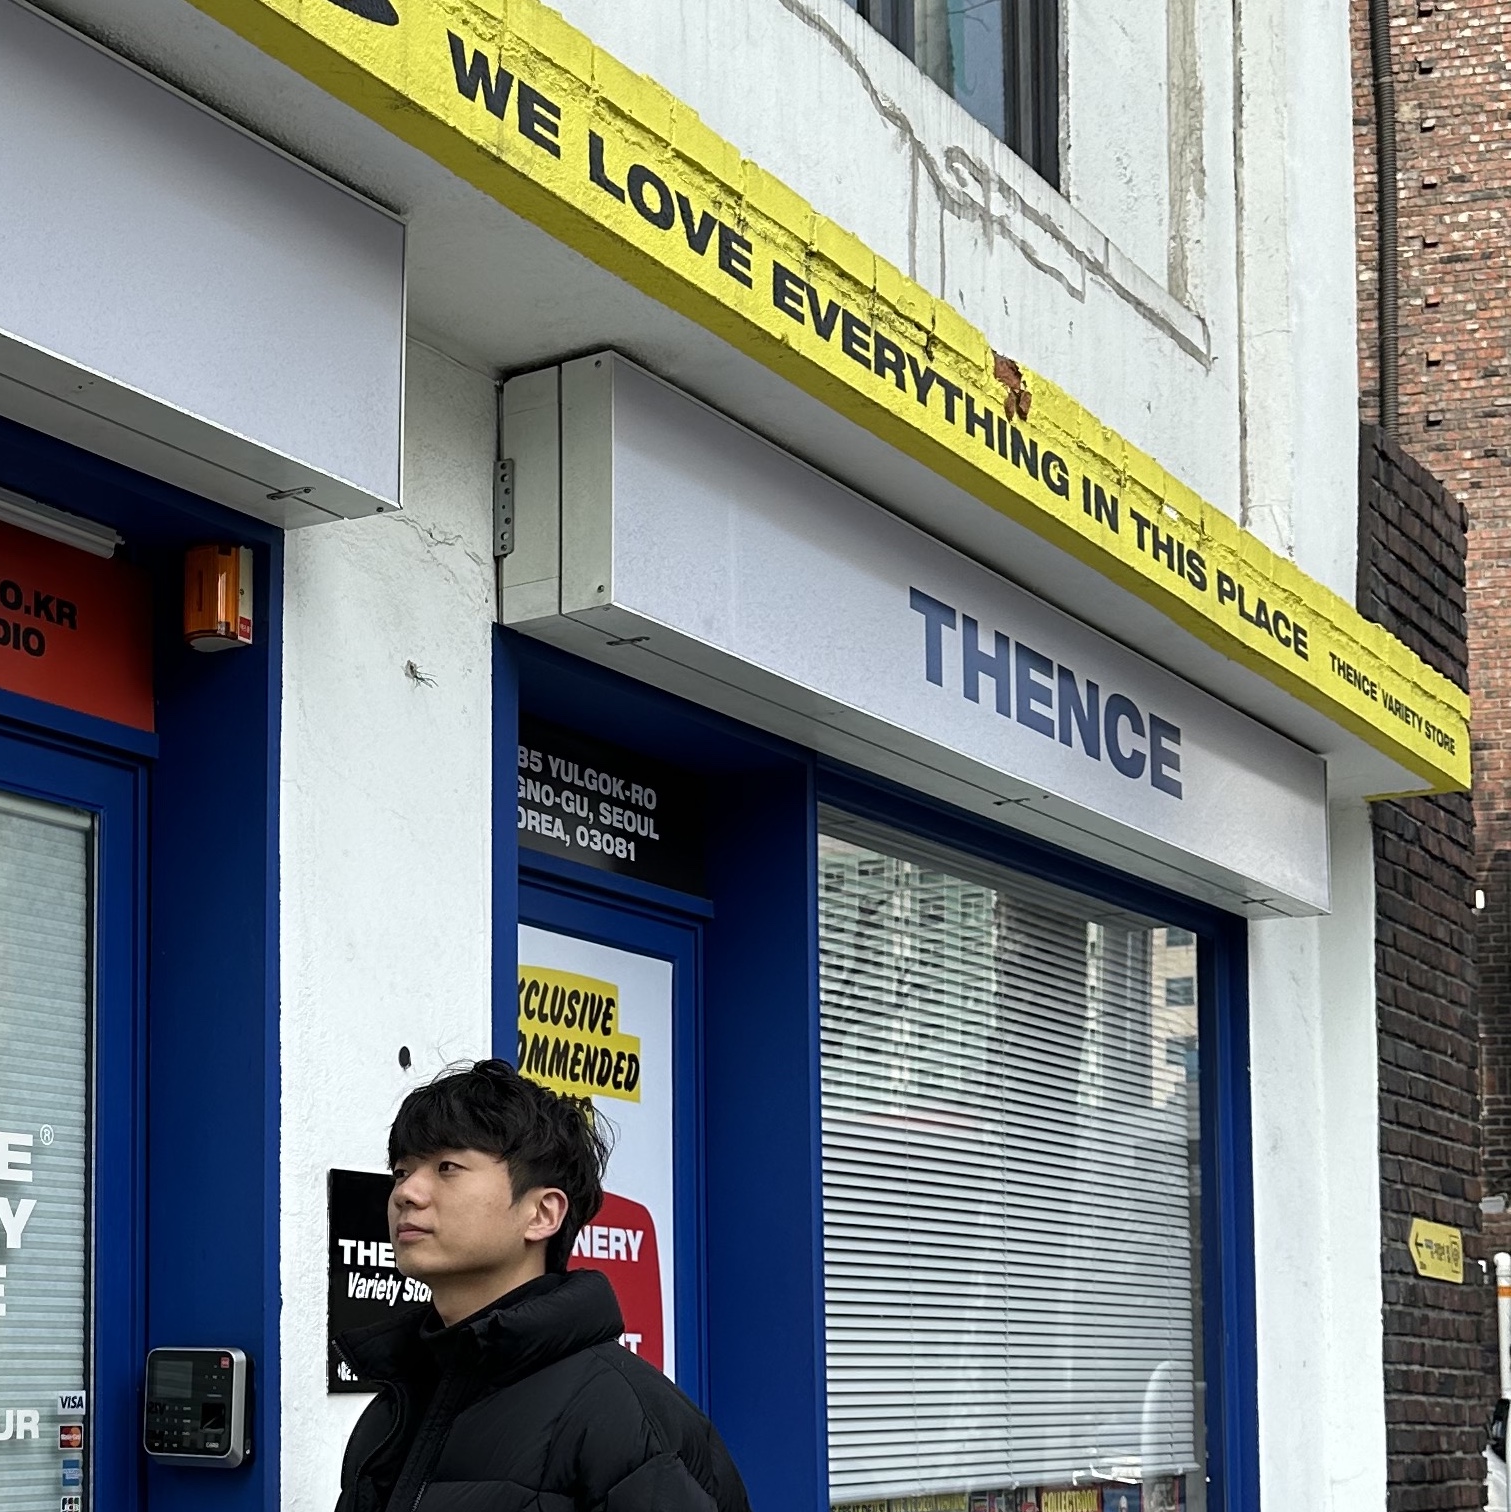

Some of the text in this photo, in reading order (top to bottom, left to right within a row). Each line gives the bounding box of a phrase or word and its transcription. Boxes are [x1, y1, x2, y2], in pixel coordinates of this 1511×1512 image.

[446, 28, 1309, 661] WE LOVE EVERYTHING IN THIS PLACE
[909, 586, 1183, 800] THENCE
[1329, 651, 1456, 756] THENCE VARIETY STORE
[547, 754, 657, 810] YULGOK-RO
[576, 825, 636, 862] 03081
[599, 801, 660, 841] SEOUL
[348, 1271, 402, 1307] Variety
[59, 1395, 84, 1409] VISA
